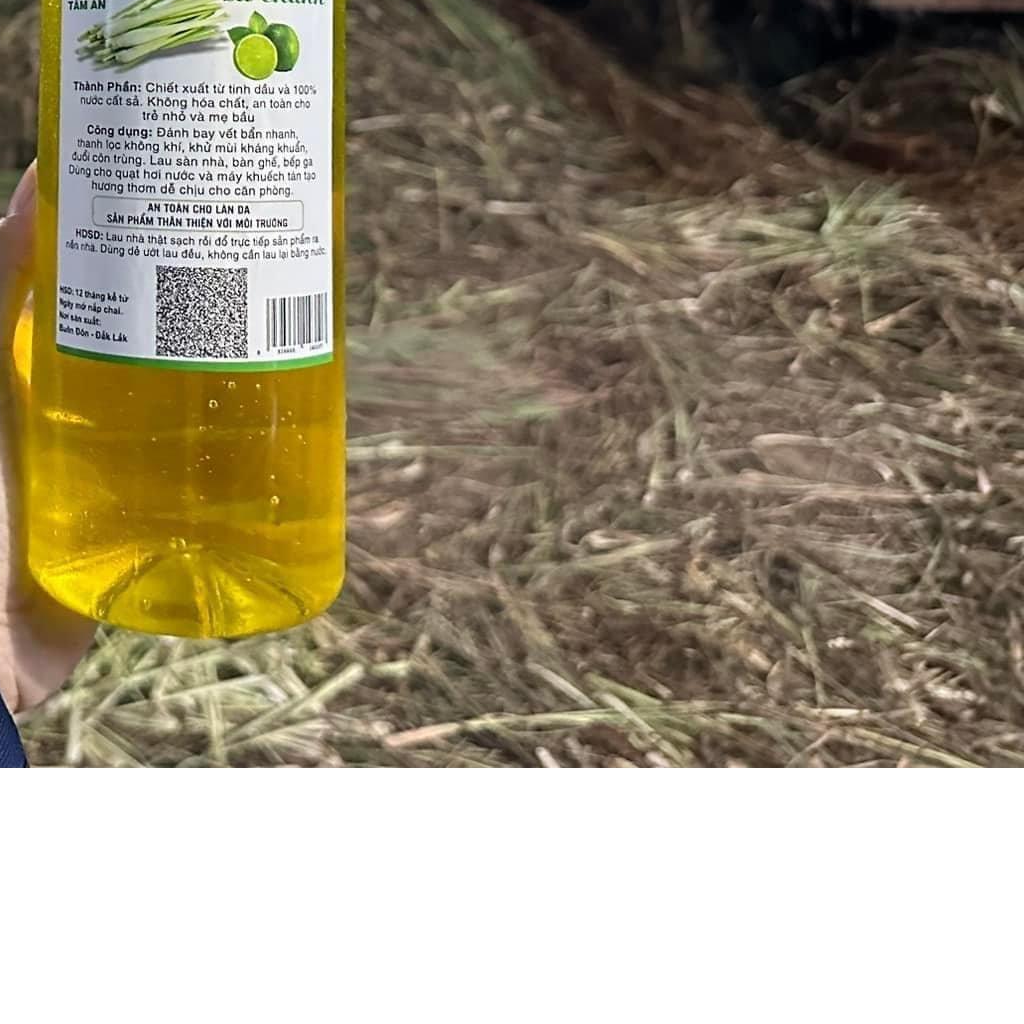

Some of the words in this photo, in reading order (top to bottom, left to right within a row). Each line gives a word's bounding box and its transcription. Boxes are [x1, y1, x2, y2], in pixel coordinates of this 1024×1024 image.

[68, 0, 88, 11] TÂM
[90, 0, 106, 10] AN
[73, 81, 104, 91] Thành
[146, 82, 178, 93] Chiết
[182, 82, 209, 93] xuất
[213, 84, 225, 94] từ
[229, 84, 251, 94] tinh
[278, 84, 290, 95] và
[294, 85, 317, 95] 100%
[106, 95, 123, 106] cất
[147, 97, 188, 109] Không
[192, 97, 215, 108] hóa
[219, 97, 249, 110] chất,
[252, 100, 266, 108] an
[270, 99, 292, 109] toàn
[294, 99, 311, 109] cho
[142, 110, 158, 121] trẻ
[162, 111, 186, 122] nhỏ
[190, 112, 205, 122] và
[209, 113, 228, 124] mẹ
[87, 125, 114, 137] Công
[118, 126, 152, 139] dụng:
[157, 127, 189, 138] Đánh
[193, 128, 215, 141] bay
[219, 128, 237, 139] vết
[241, 126, 262, 139] bẩn
[77, 138, 102, 149] thanh
[106, 140, 121, 151] lọc
[124, 140, 160, 153] không
[189, 142, 212, 153] khử
[216, 142, 236, 153] mùi
[241, 143, 274, 155] kháng
[150, 155, 172, 166] Lau
[176, 156, 198, 166] sàn
[233, 157, 254, 167] bàn
[283, 156, 301, 169] bếp
[94, 167, 112, 177] cho
[115, 169, 140, 180] quạt
[165, 171, 195, 181] nước
[199, 171, 213, 181] và
[217, 171, 242, 184] máy
[92, 180, 124, 194] hương
[128, 182, 156, 193] thơm
[179, 185, 205, 197] chịu
[209, 185, 230, 196] cho
[148, 203, 160, 212] AN
[193, 204, 212, 214] CHO
[238, 205, 250, 214] DA
[75, 228, 104, 240] HDSD:
[106, 232, 123, 242] Lau
[126, 233, 145, 243] nhà
[148, 234, 167, 245] thật
[170, 235, 195, 247] sạch
[100, 243, 125, 256] Dùng
[163, 247, 178, 258] lau
[208, 249, 239, 262] không
[263, 249, 276, 260] lau
[76, 289, 83, 297] 12
